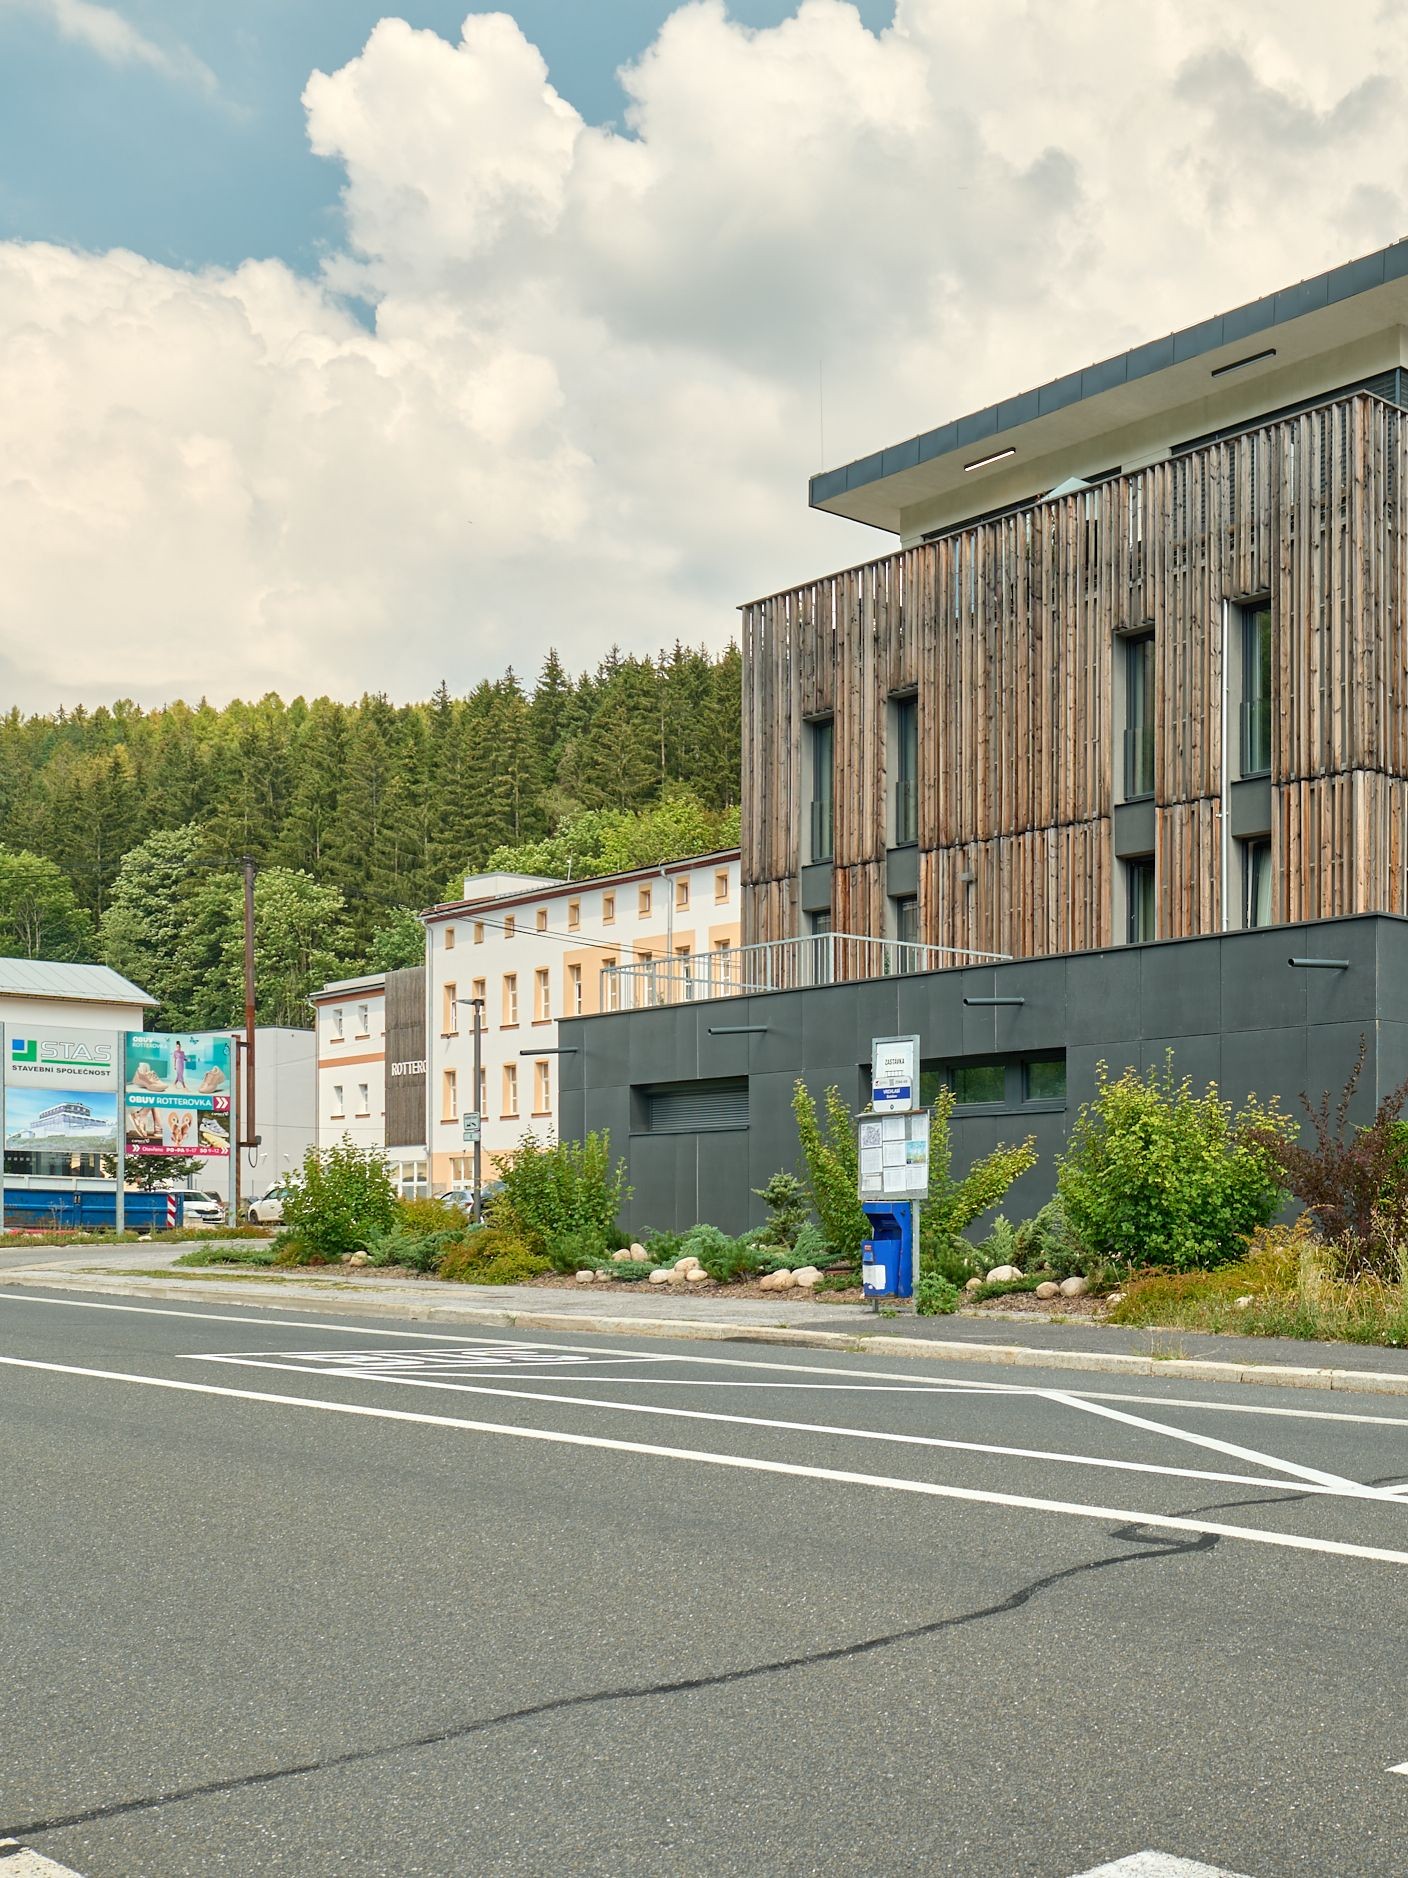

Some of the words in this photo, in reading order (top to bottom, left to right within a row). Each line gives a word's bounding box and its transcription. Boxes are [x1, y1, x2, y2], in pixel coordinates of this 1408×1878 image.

[41, 1041, 112, 1062] STAS
[128, 1095, 155, 1104] OBUV
[156, 1096, 212, 1107] ROTTEROVKA
